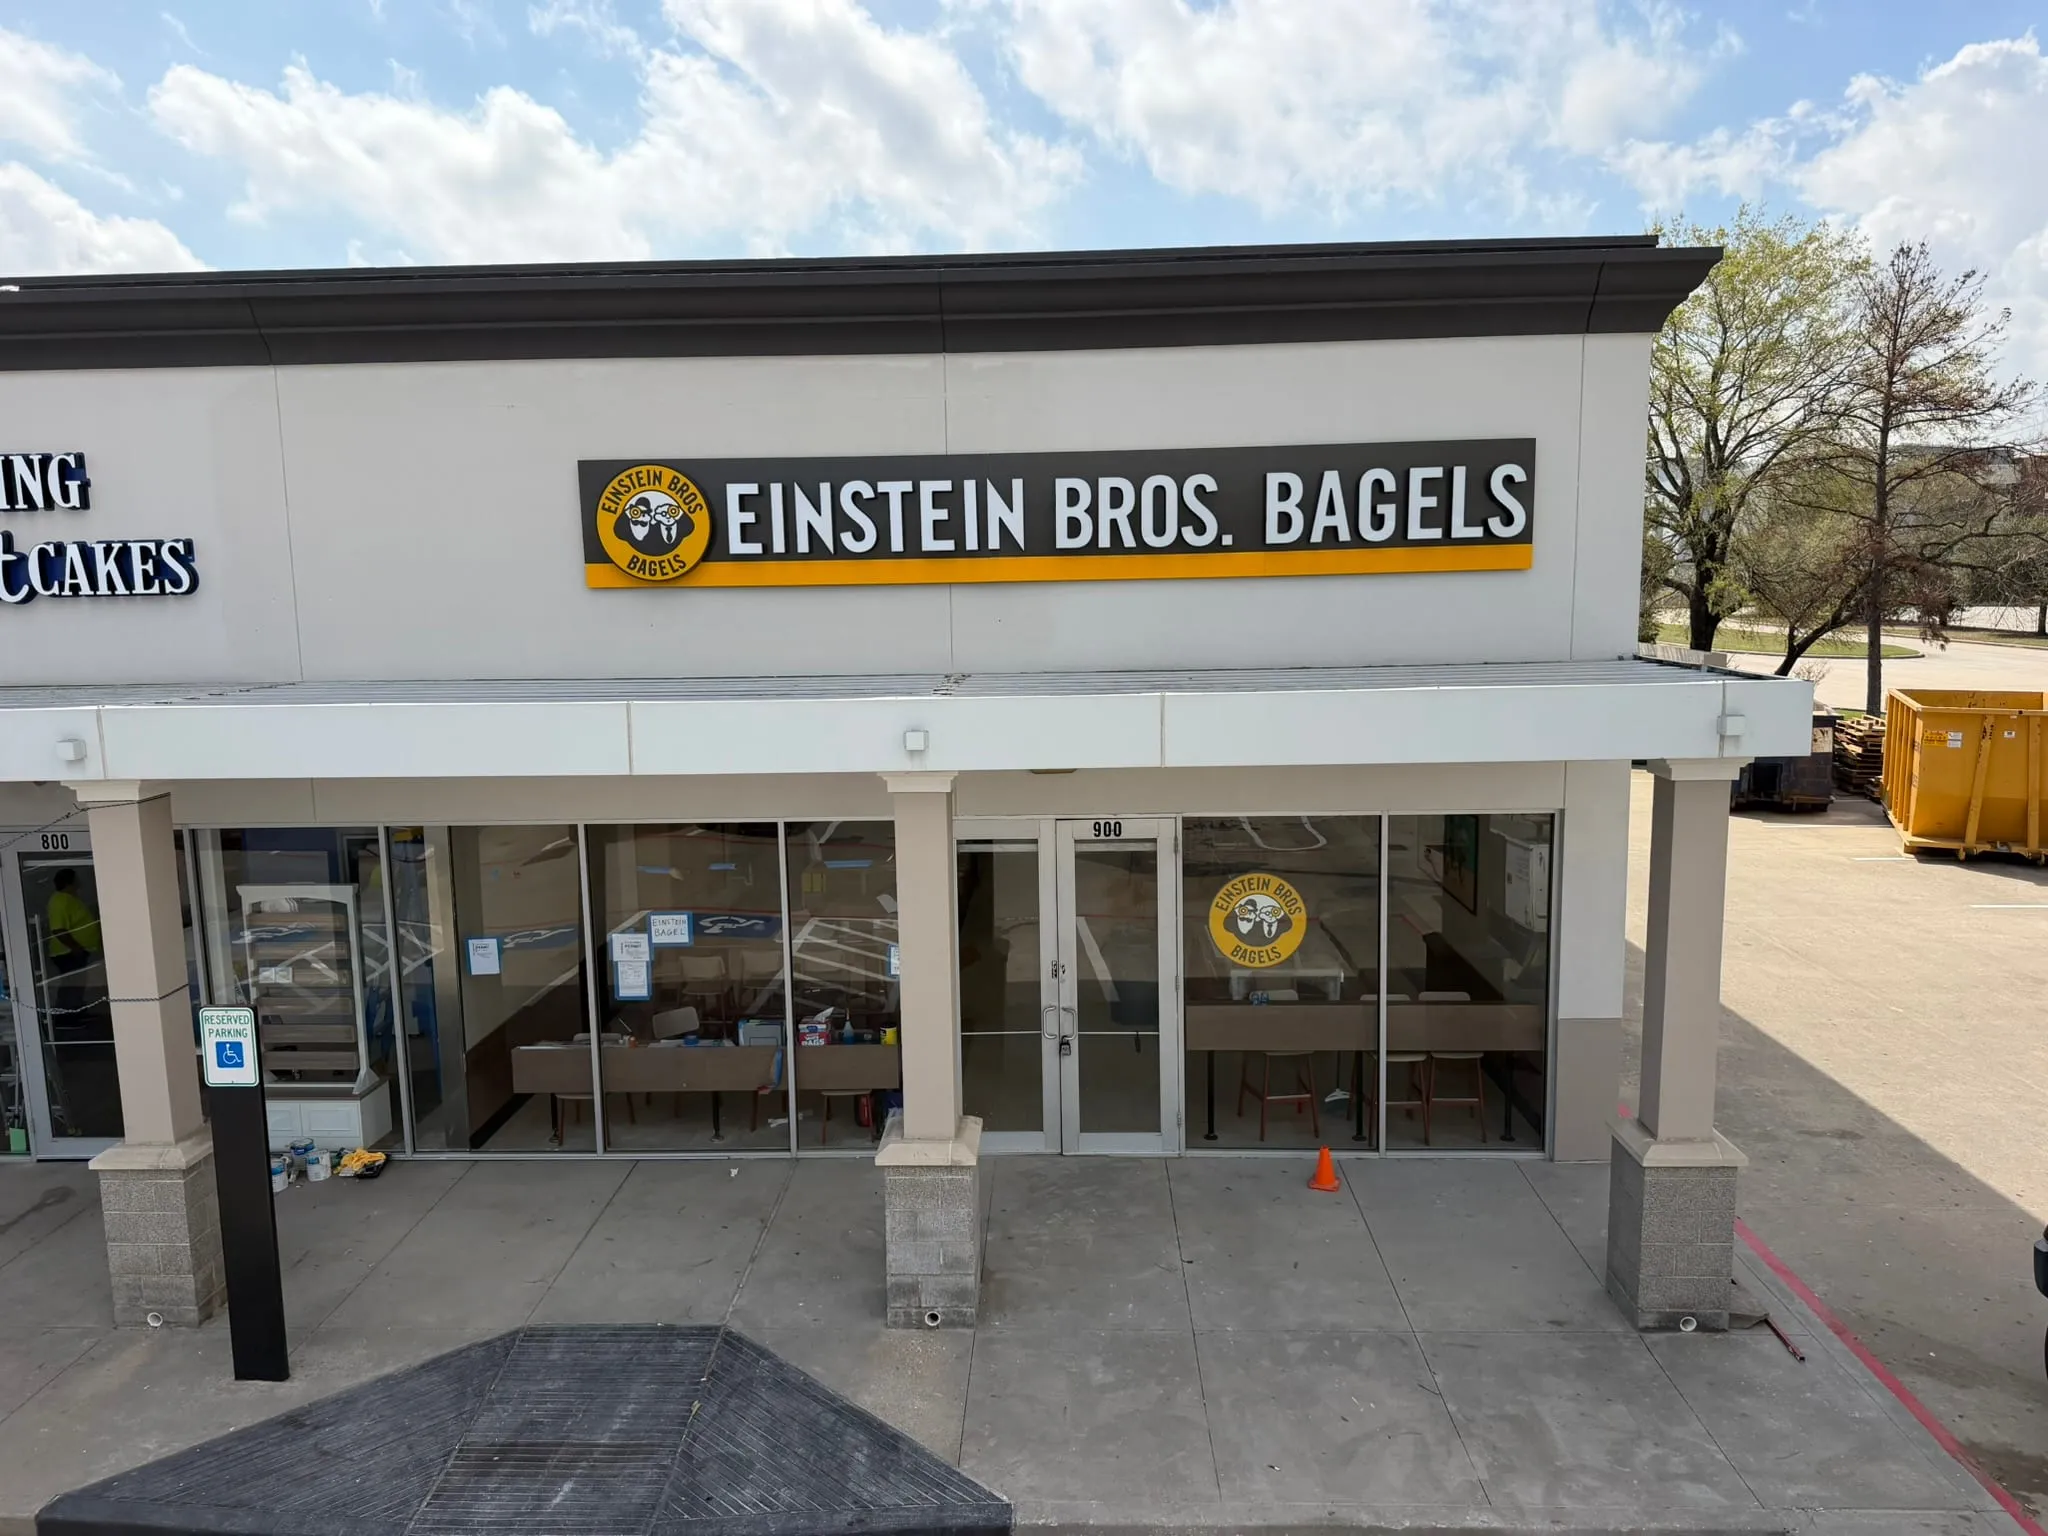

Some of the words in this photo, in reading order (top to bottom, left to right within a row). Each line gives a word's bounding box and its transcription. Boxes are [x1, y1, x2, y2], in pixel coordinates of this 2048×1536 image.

[601, 469, 663, 515] EINSTEIN
[667, 475, 703, 514] BROS
[725, 478, 1025, 555] EINSTEIN
[1054, 473, 1234, 549] BROS.
[1265, 463, 1528, 545] BAGELS
[28, 540, 195, 597] CAKES
[626, 554, 687, 577] BAGELS
[1093, 821, 1122, 838] 900
[41, 833, 69, 850] 800
[1215, 877, 1271, 912] EINSTEIN
[1273, 883, 1301, 916] BROS
[654, 928, 687, 937] BAGEL
[1231, 945, 1281, 964] BAGELS
[204, 1015, 250, 1025] RESERVED
[208, 1028, 248, 1038] PARKING
